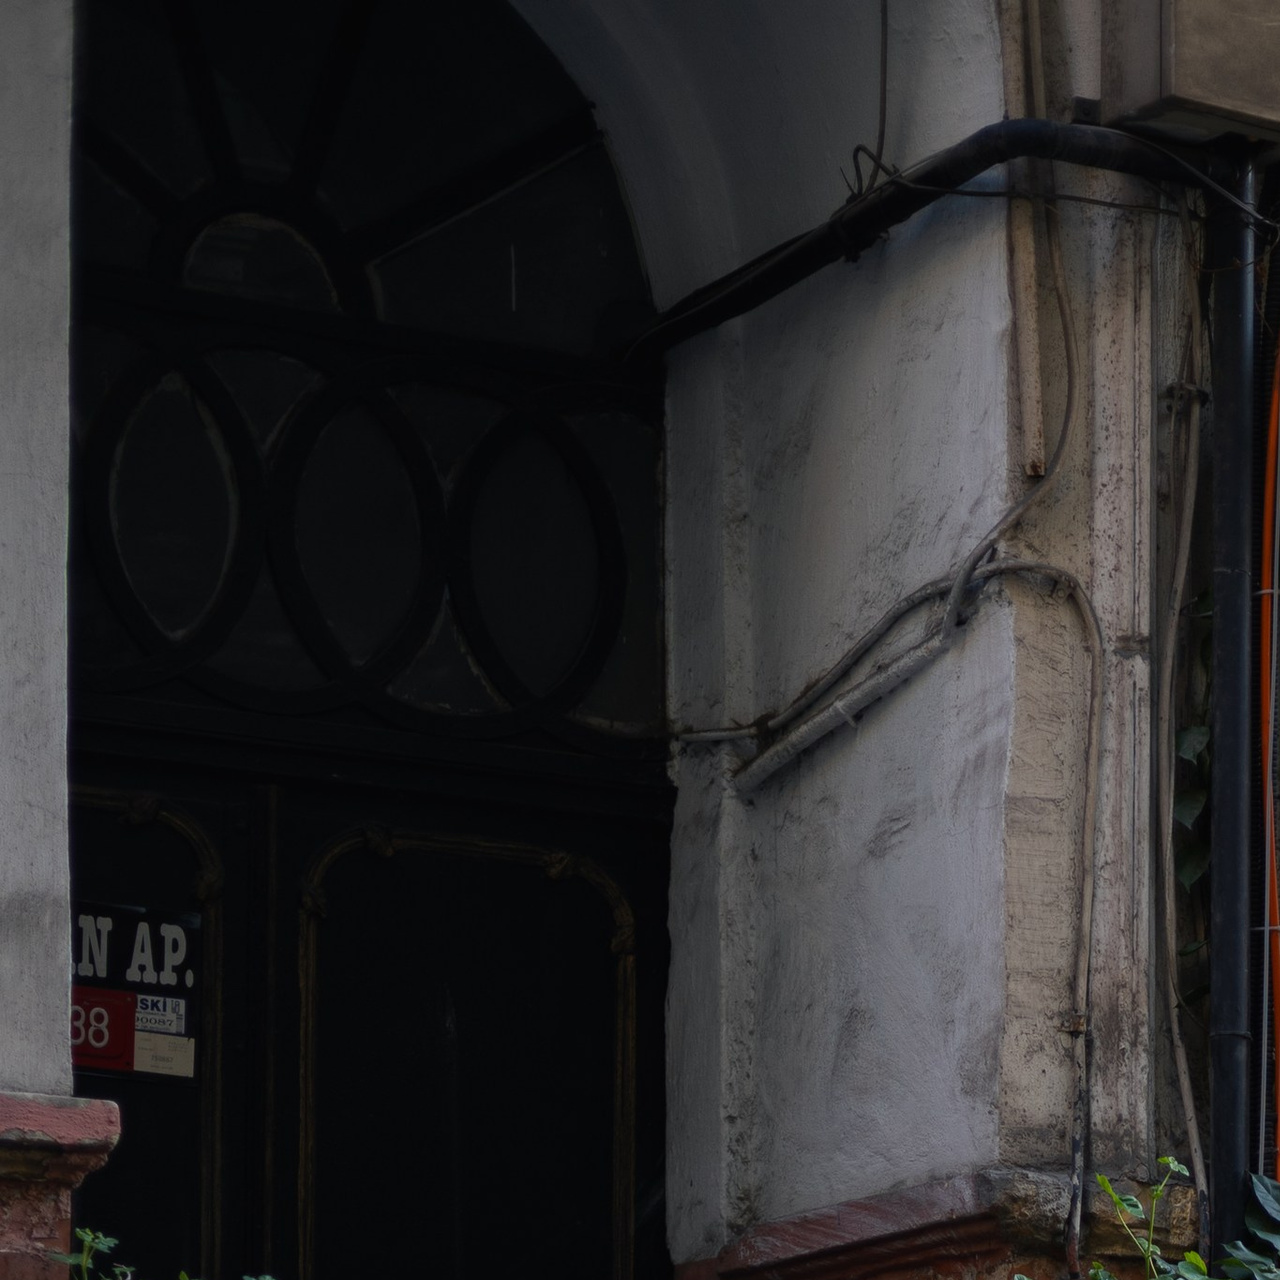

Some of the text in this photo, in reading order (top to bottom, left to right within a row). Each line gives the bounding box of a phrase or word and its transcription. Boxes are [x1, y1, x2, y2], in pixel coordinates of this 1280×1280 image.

[72, 914, 194, 988] N AP.
[71, 1005, 109, 1048] 38
